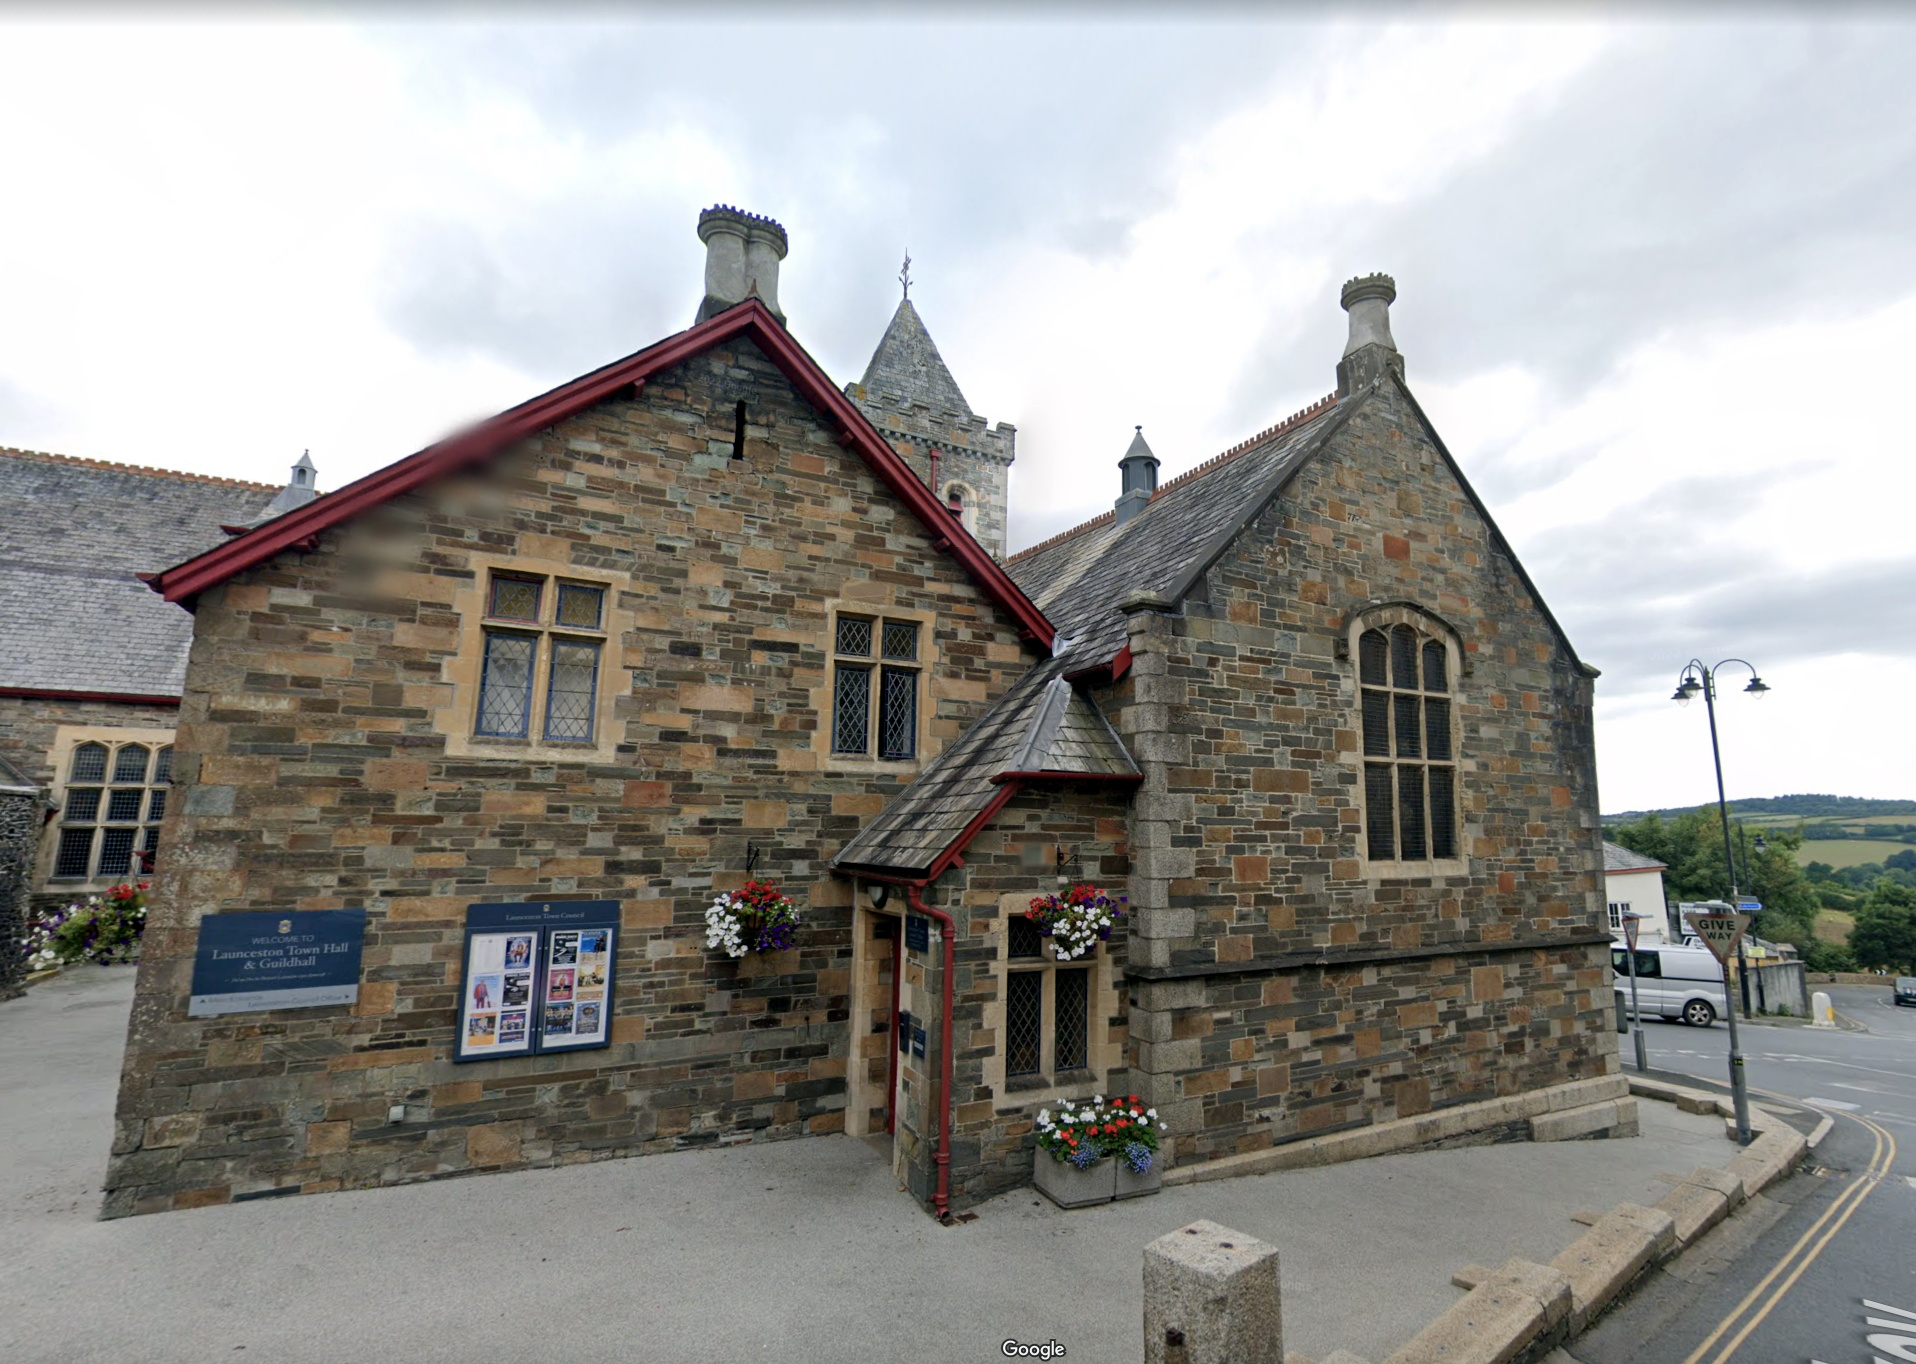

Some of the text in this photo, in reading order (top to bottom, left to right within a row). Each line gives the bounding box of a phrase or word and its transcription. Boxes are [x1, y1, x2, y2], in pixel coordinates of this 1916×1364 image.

[1699, 919, 1735, 930] GIVE
[252, 936, 299, 944] WELCOME
[1706, 931, 1732, 940] WAY
[212, 942, 349, 959] Launceston Town Hall
[243, 956, 316, 970] & Guildhall
